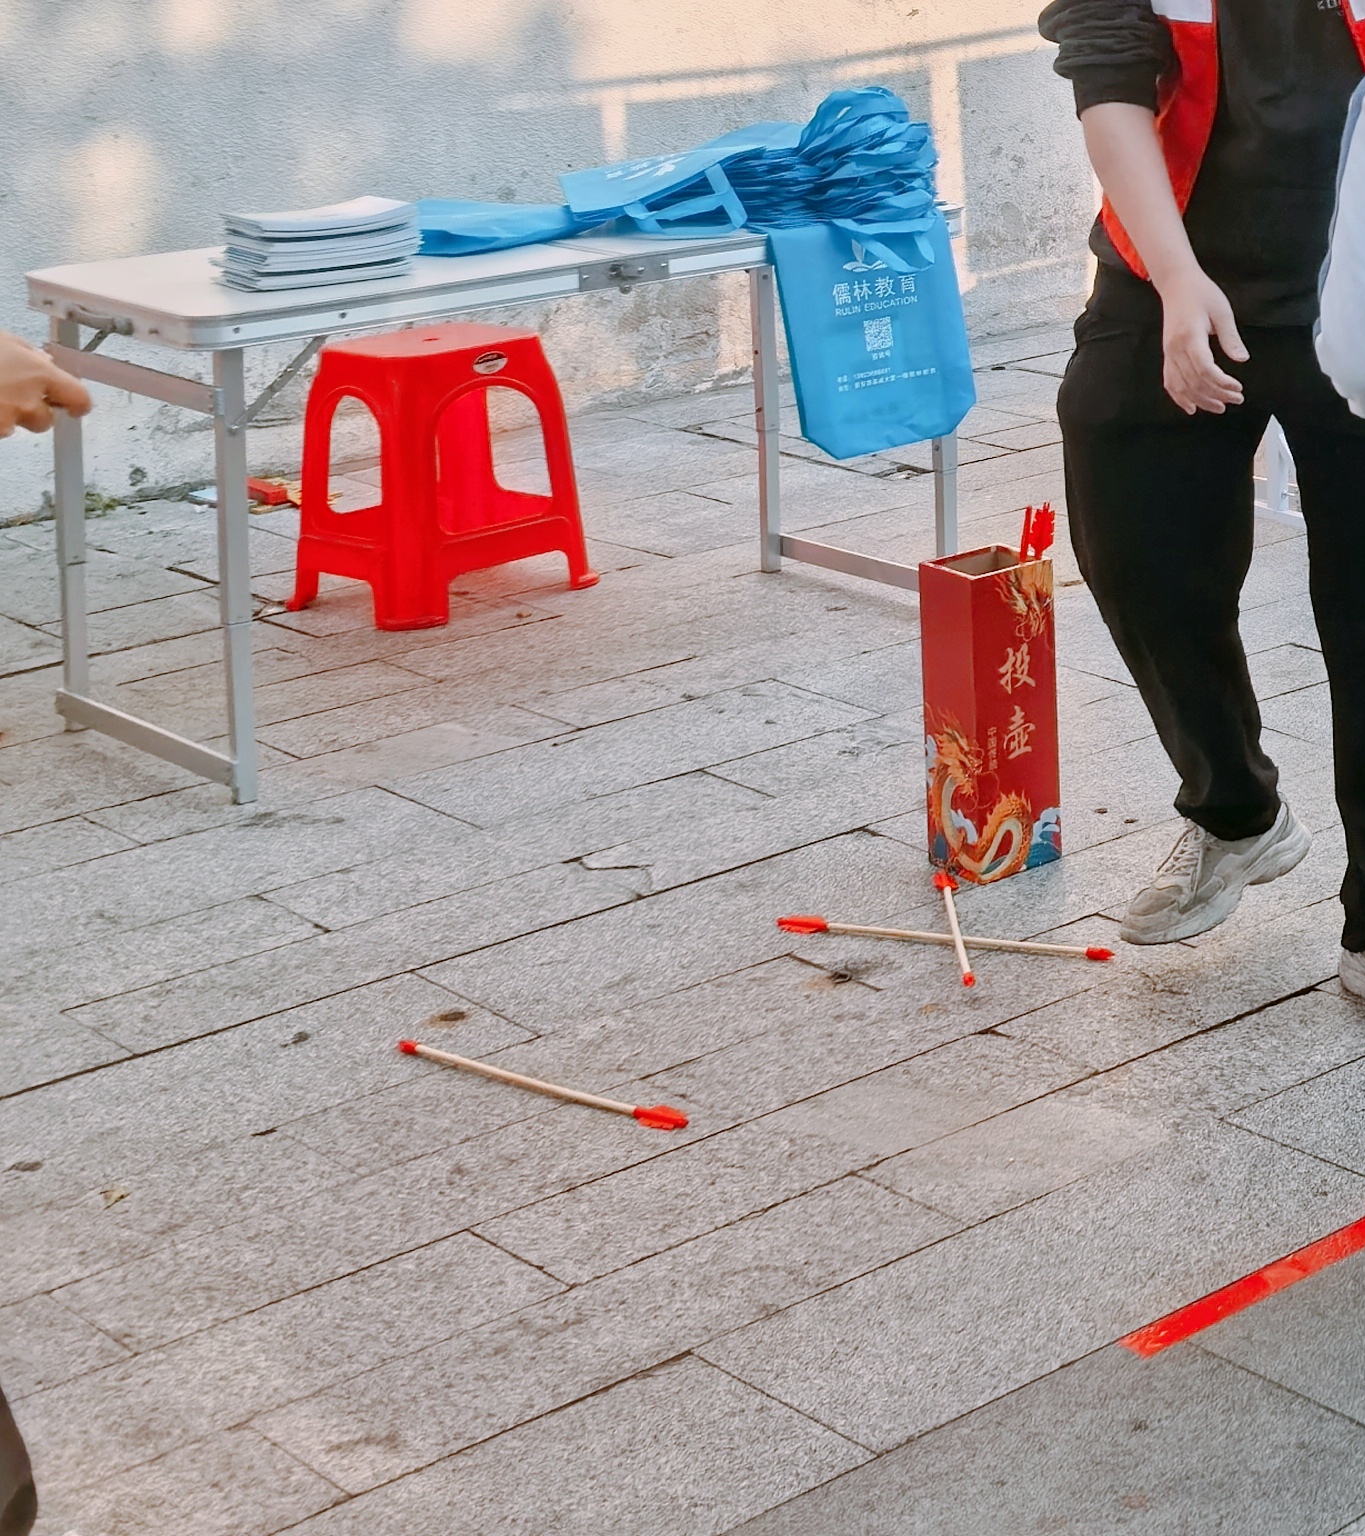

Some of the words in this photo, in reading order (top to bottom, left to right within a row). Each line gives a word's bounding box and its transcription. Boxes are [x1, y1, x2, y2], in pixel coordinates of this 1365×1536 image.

[833, 273, 917, 306] 儒林教育
[835, 305, 861, 317] RULIN
[864, 295, 918, 312] EDUCATION
[998, 642, 1037, 761] 投壶
